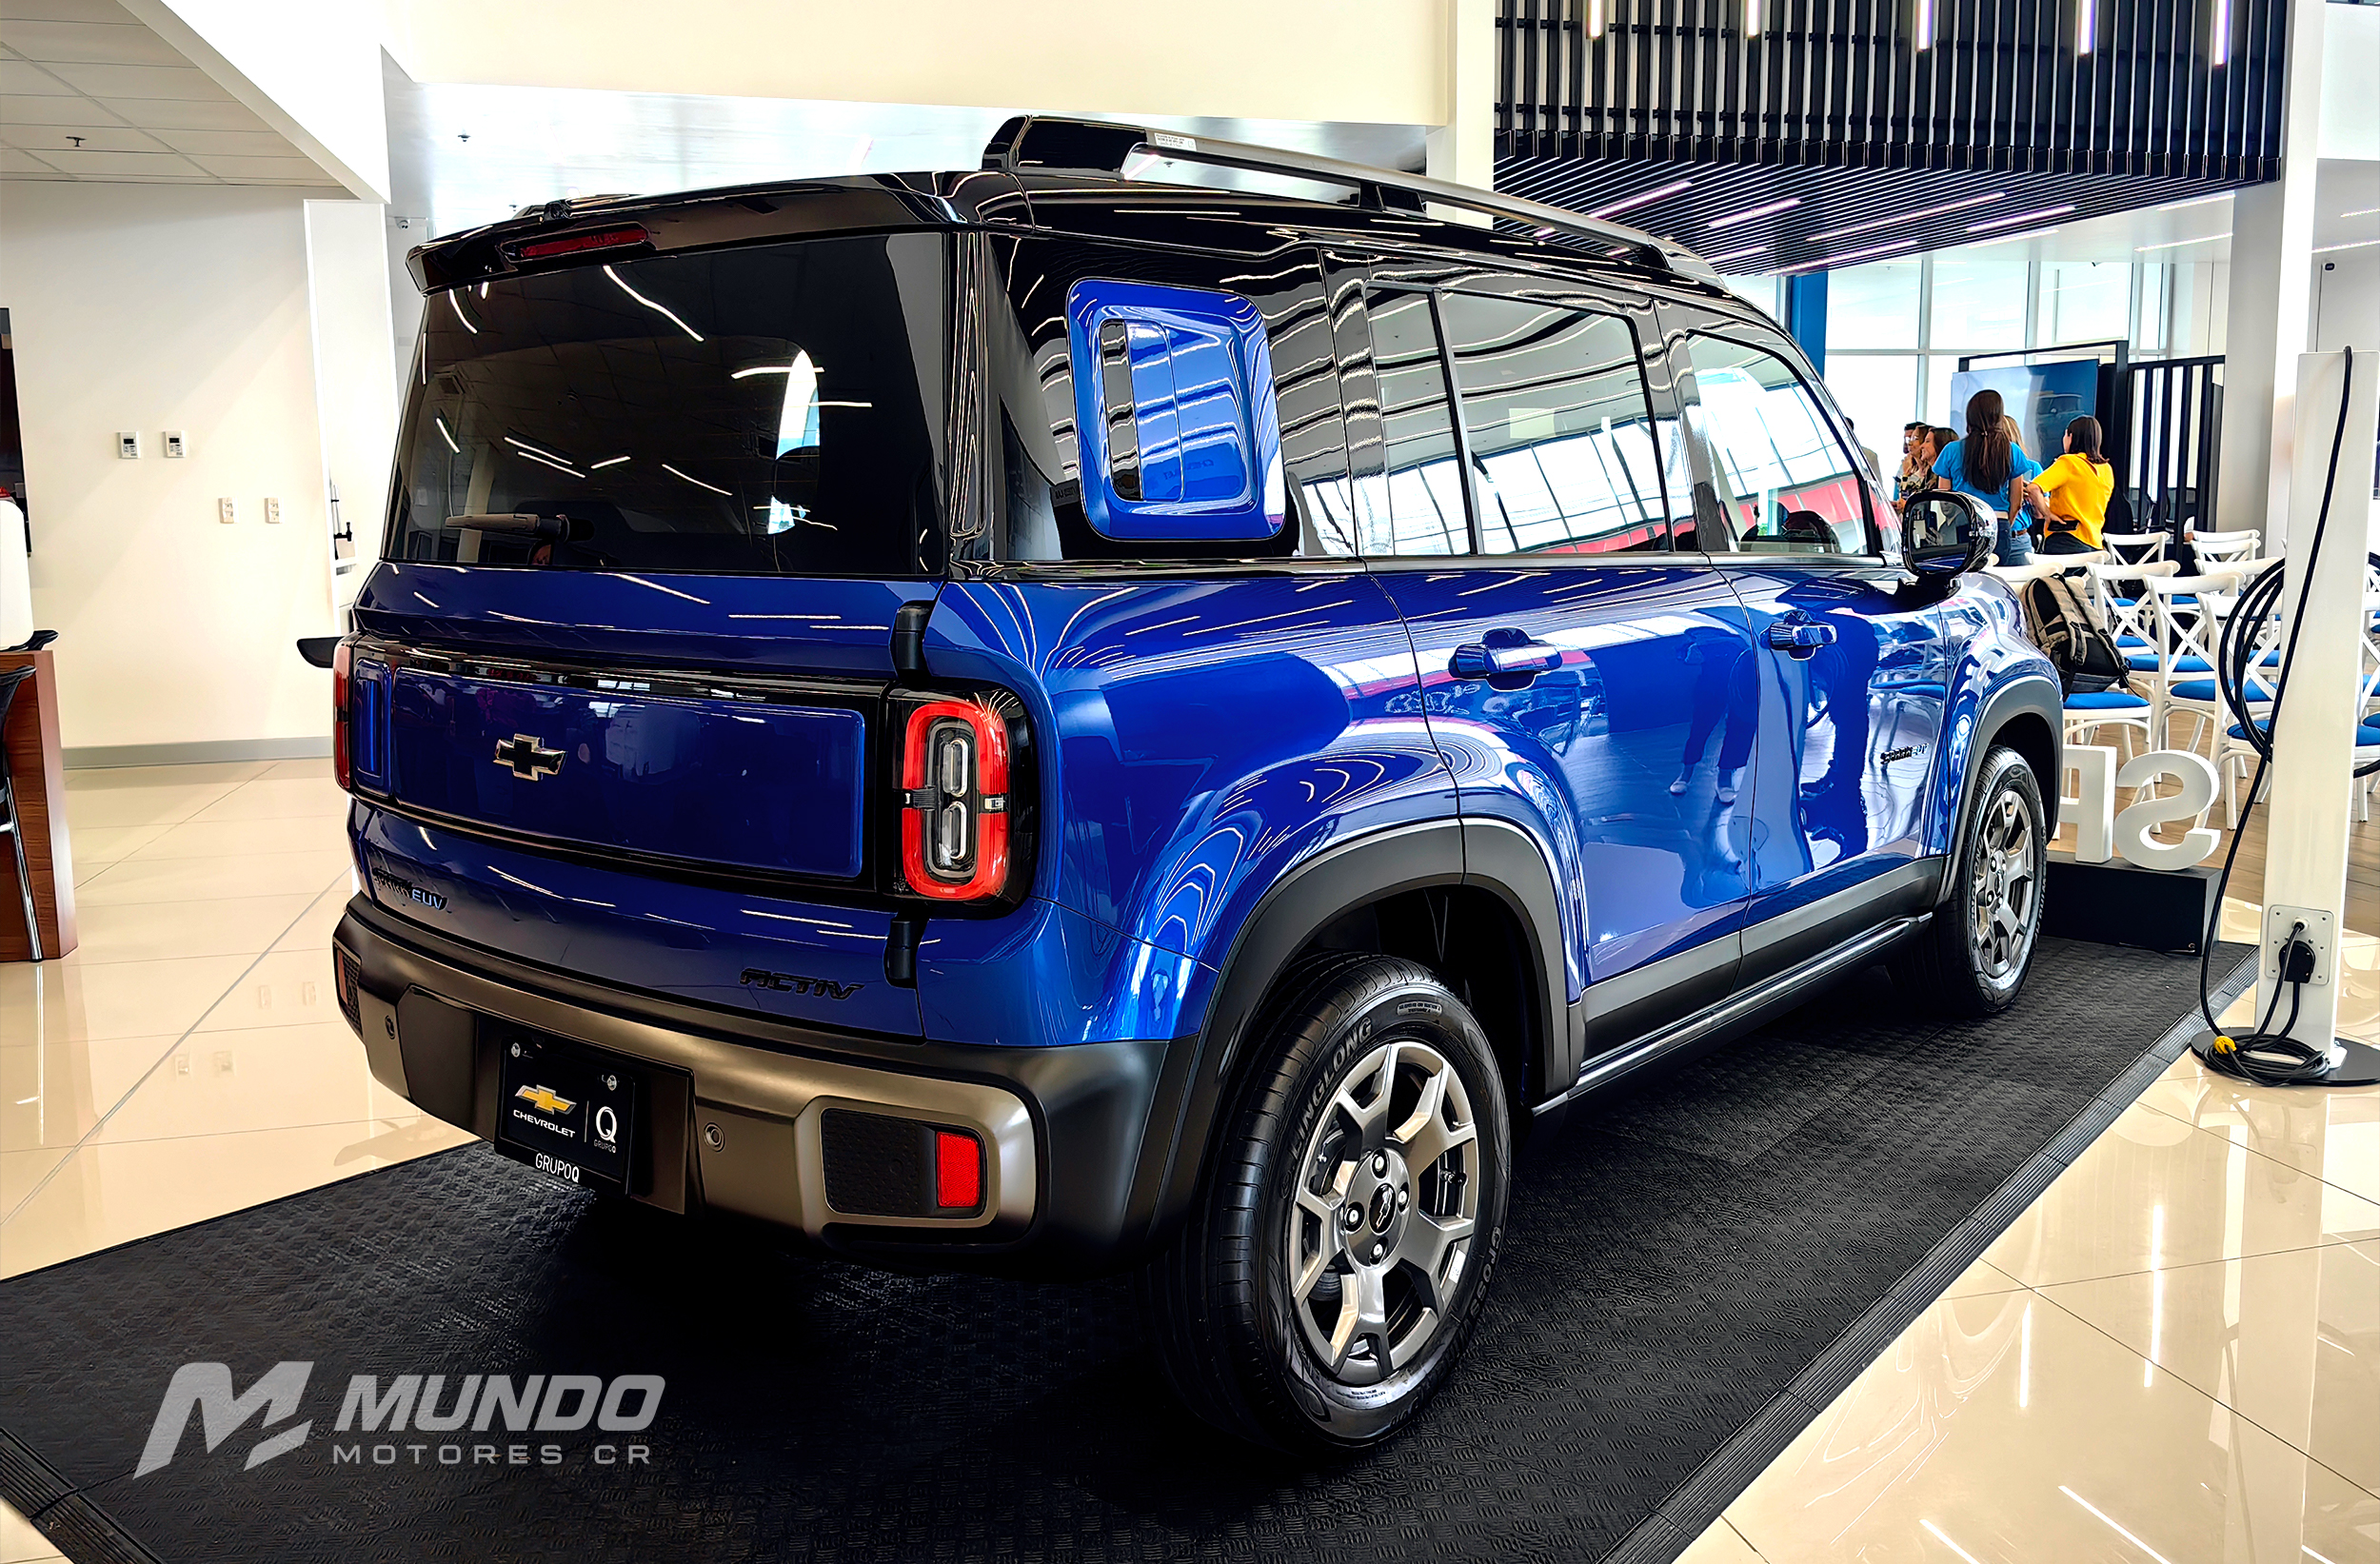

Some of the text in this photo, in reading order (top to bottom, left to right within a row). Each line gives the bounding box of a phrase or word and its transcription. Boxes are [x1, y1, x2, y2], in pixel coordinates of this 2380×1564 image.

[411, 887, 446, 910] EUV
[739, 966, 865, 1000] ACTIV
[1289, 1016, 1372, 1160] LINGLONG
[512, 1109, 576, 1138] CHEVROLET
[535, 1152, 580, 1183] GRUPOQ
